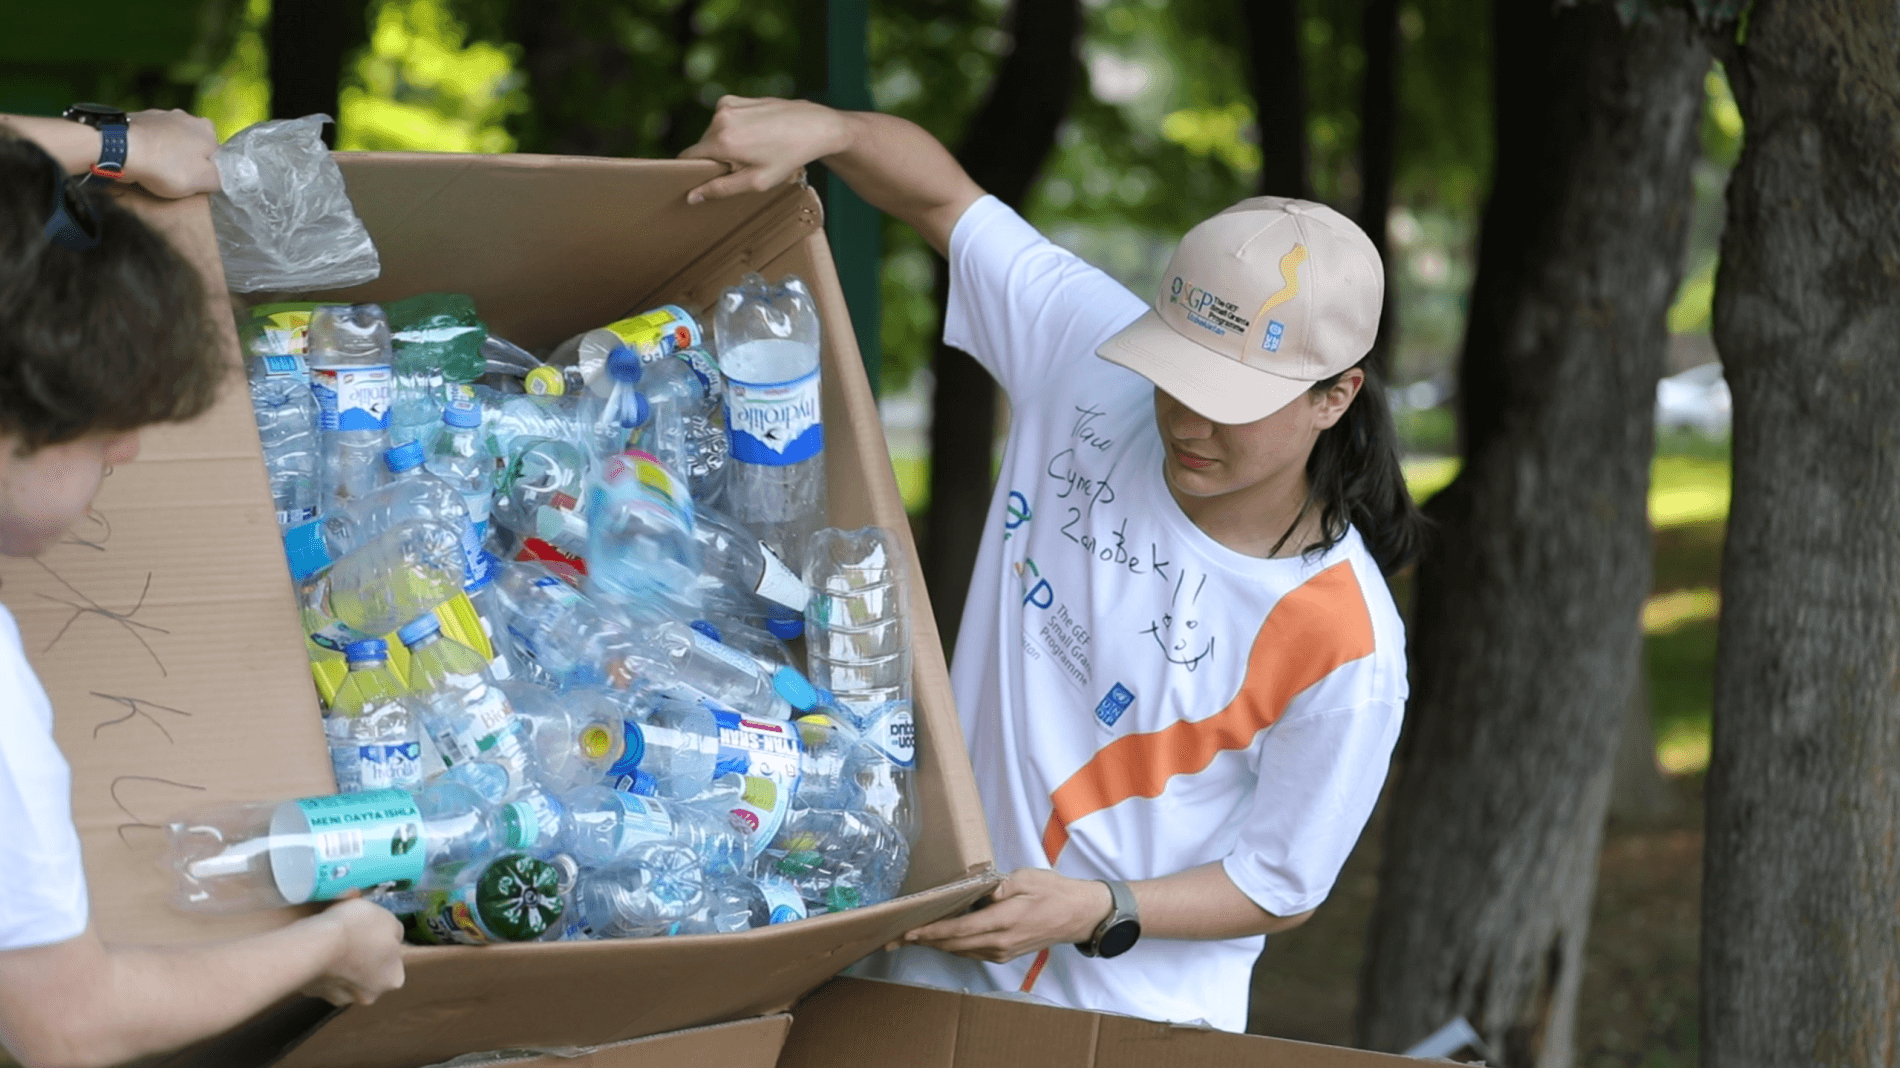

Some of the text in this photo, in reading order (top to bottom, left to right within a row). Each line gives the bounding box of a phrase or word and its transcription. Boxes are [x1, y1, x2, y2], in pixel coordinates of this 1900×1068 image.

[1182, 281, 1213, 312] SGP
[1214, 296, 1226, 308] The
[1208, 311, 1245, 333] Programme
[1210, 304, 1250, 327] Small Grants
[1057, 603, 1074, 628] The
[1039, 626, 1088, 687] Programme
[1047, 614, 1093, 681] Small Gran
